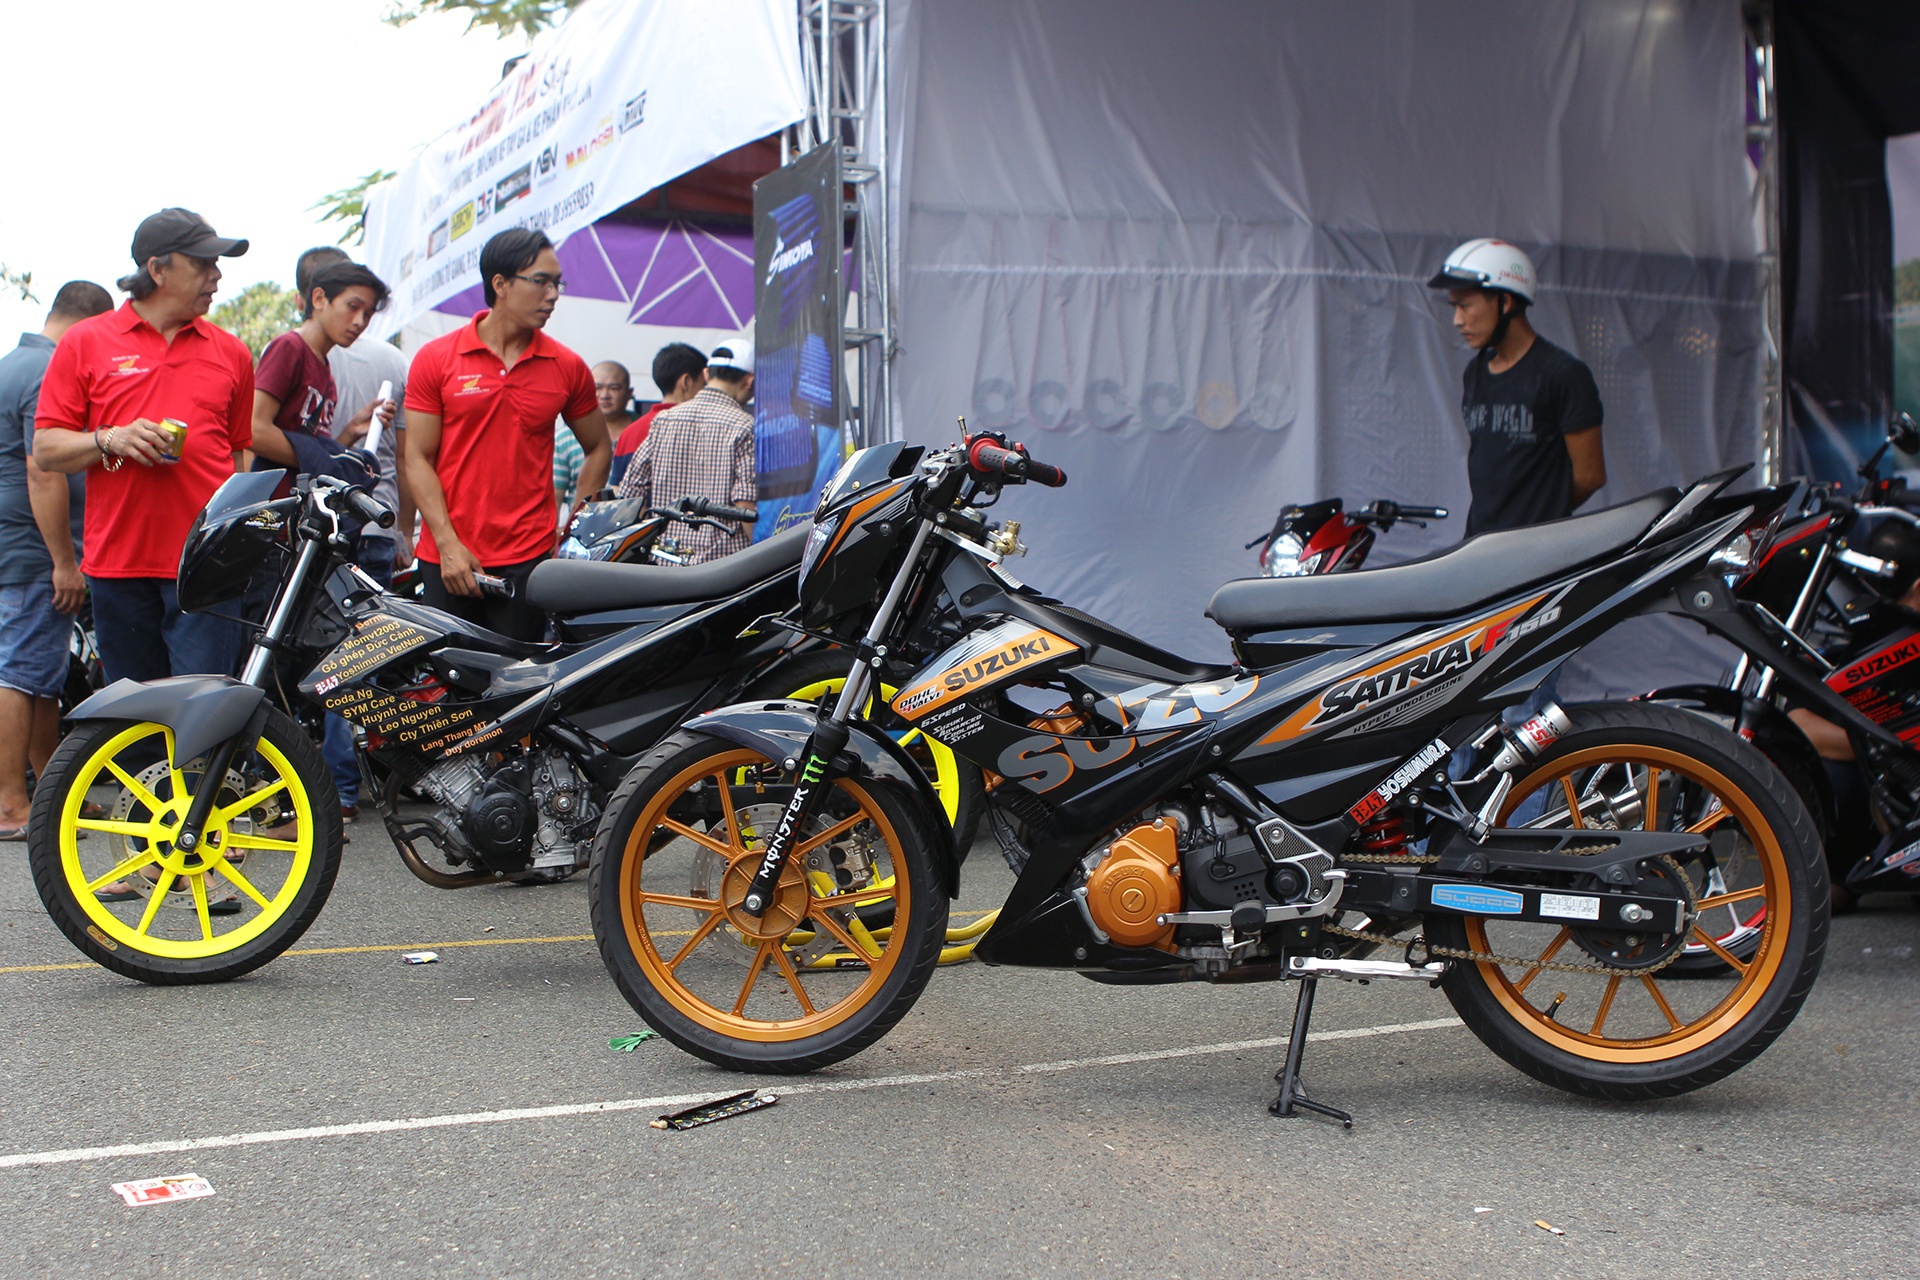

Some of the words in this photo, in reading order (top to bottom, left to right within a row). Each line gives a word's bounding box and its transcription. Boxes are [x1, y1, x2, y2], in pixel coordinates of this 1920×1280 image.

[533, 142, 558, 179] ASV
[765, 236, 814, 286] SIMOTA
[336, 652, 387, 680] Yoshimura
[944, 637, 1051, 692] SUZUKI
[1300, 625, 1487, 731] SATRIA
[1845, 643, 1920, 684] SUZUKI
[325, 693, 355, 709] Coda
[356, 689, 373, 699] Ng
[343, 704, 369, 719] SYM
[370, 695, 396, 710] Care
[361, 706, 397, 726] Huỳnh
[398, 700, 418, 713] Gia
[900, 685, 937, 709] DOHC
[1353, 710, 1391, 734] HYPER
[1395, 674, 1465, 713] UNDERBONE
[378, 720, 399, 734] Leo
[401, 705, 442, 726] Nguyen
[400, 729, 418, 742] Cty
[419, 717, 449, 735] Thiên
[451, 708, 473, 723] Sơn
[950, 725, 985, 745] SYSTEM
[421, 738, 445, 752] Lang
[444, 728, 473, 744] Thang
[473, 720, 487, 732] MT
[463, 727, 503, 749] doremon
[1376, 737, 1452, 802] YOSHIMURA
[759, 787, 810, 879] MONSTER
[1102, 867, 1145, 895] SUZUKI
